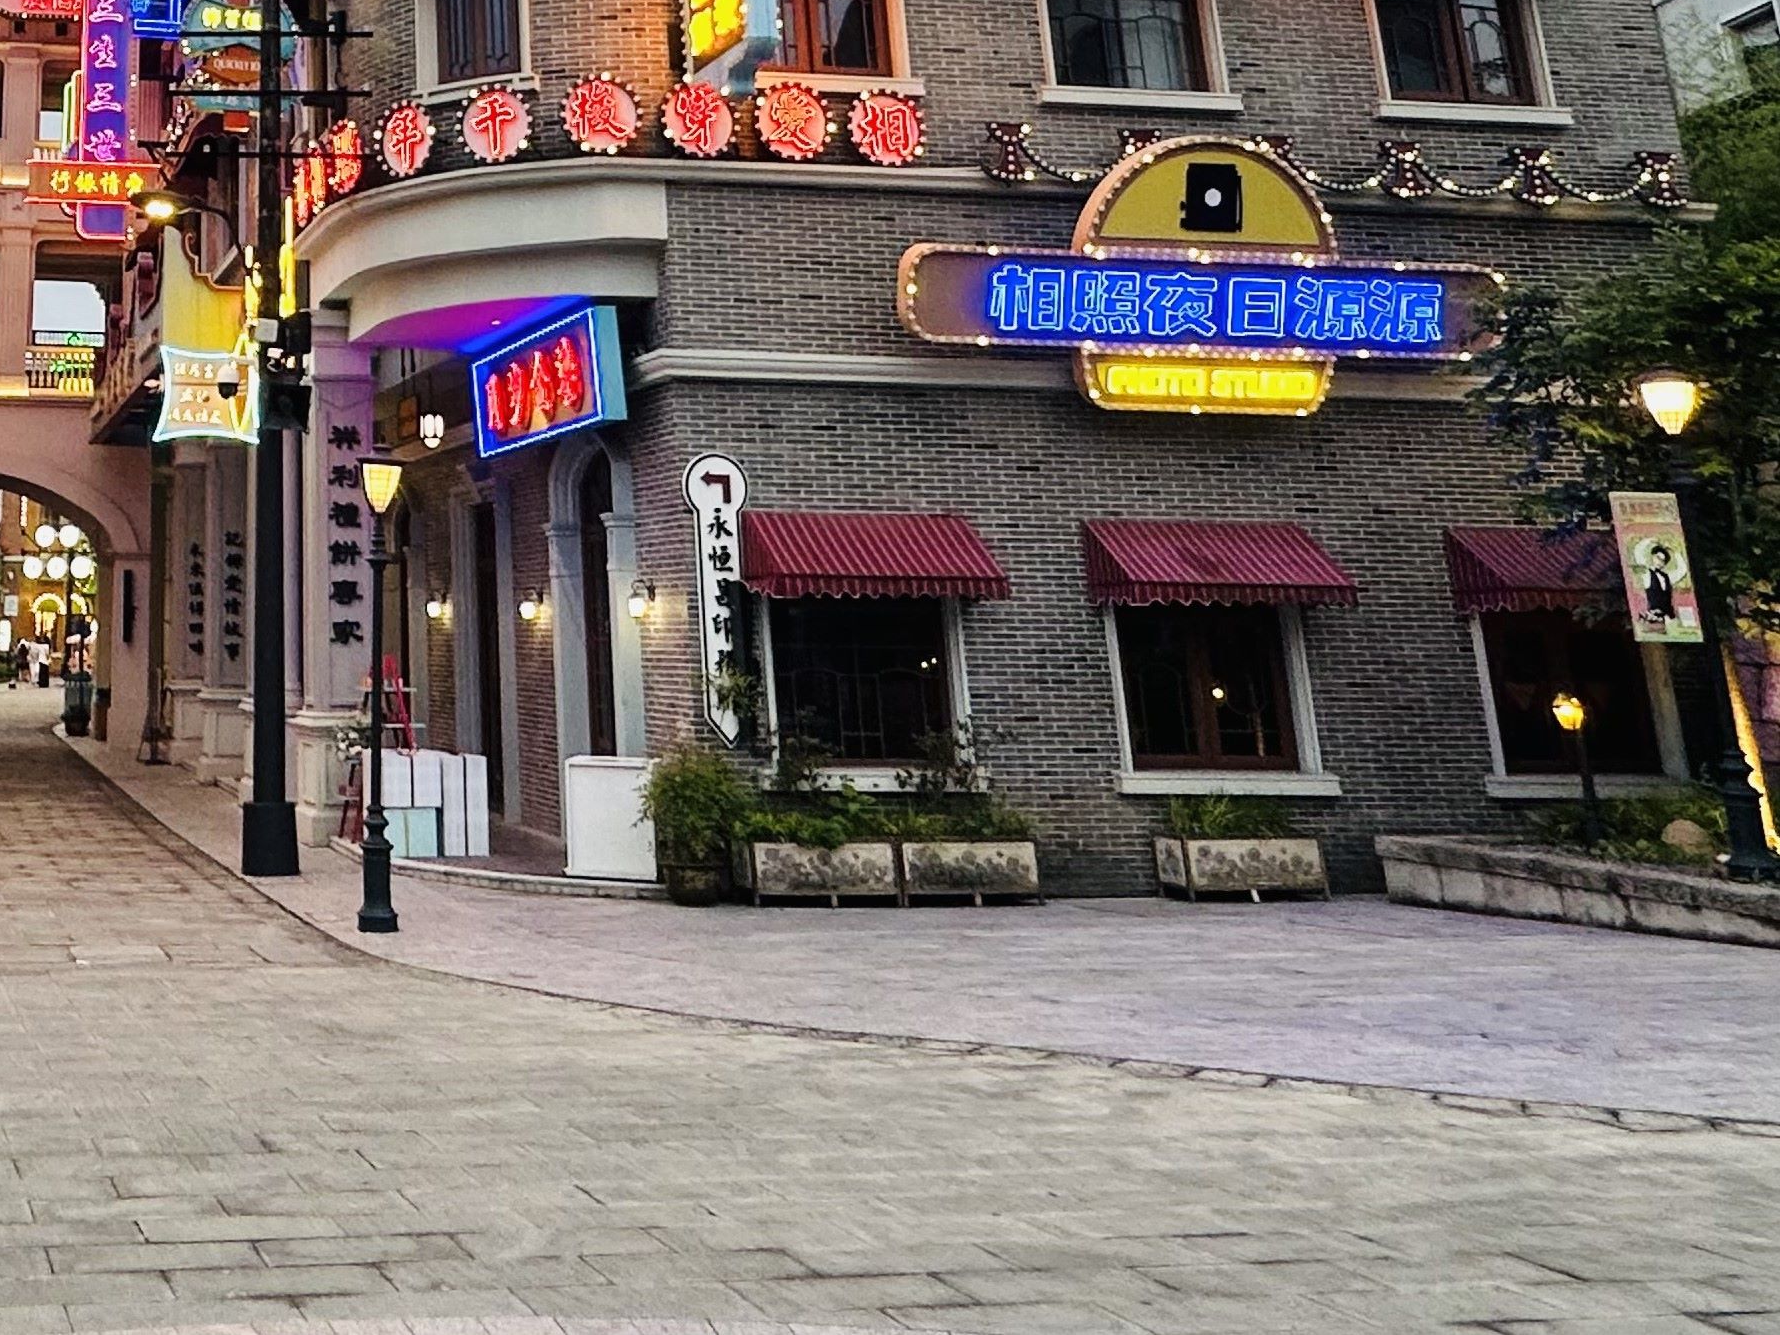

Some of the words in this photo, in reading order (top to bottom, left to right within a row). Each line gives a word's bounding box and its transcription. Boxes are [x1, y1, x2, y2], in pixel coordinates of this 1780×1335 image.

[989, 263, 1444, 343] 源源日夜照相
[1107, 366, 1206, 397] PHOTO
[1210, 369, 1319, 401] STUDIO
